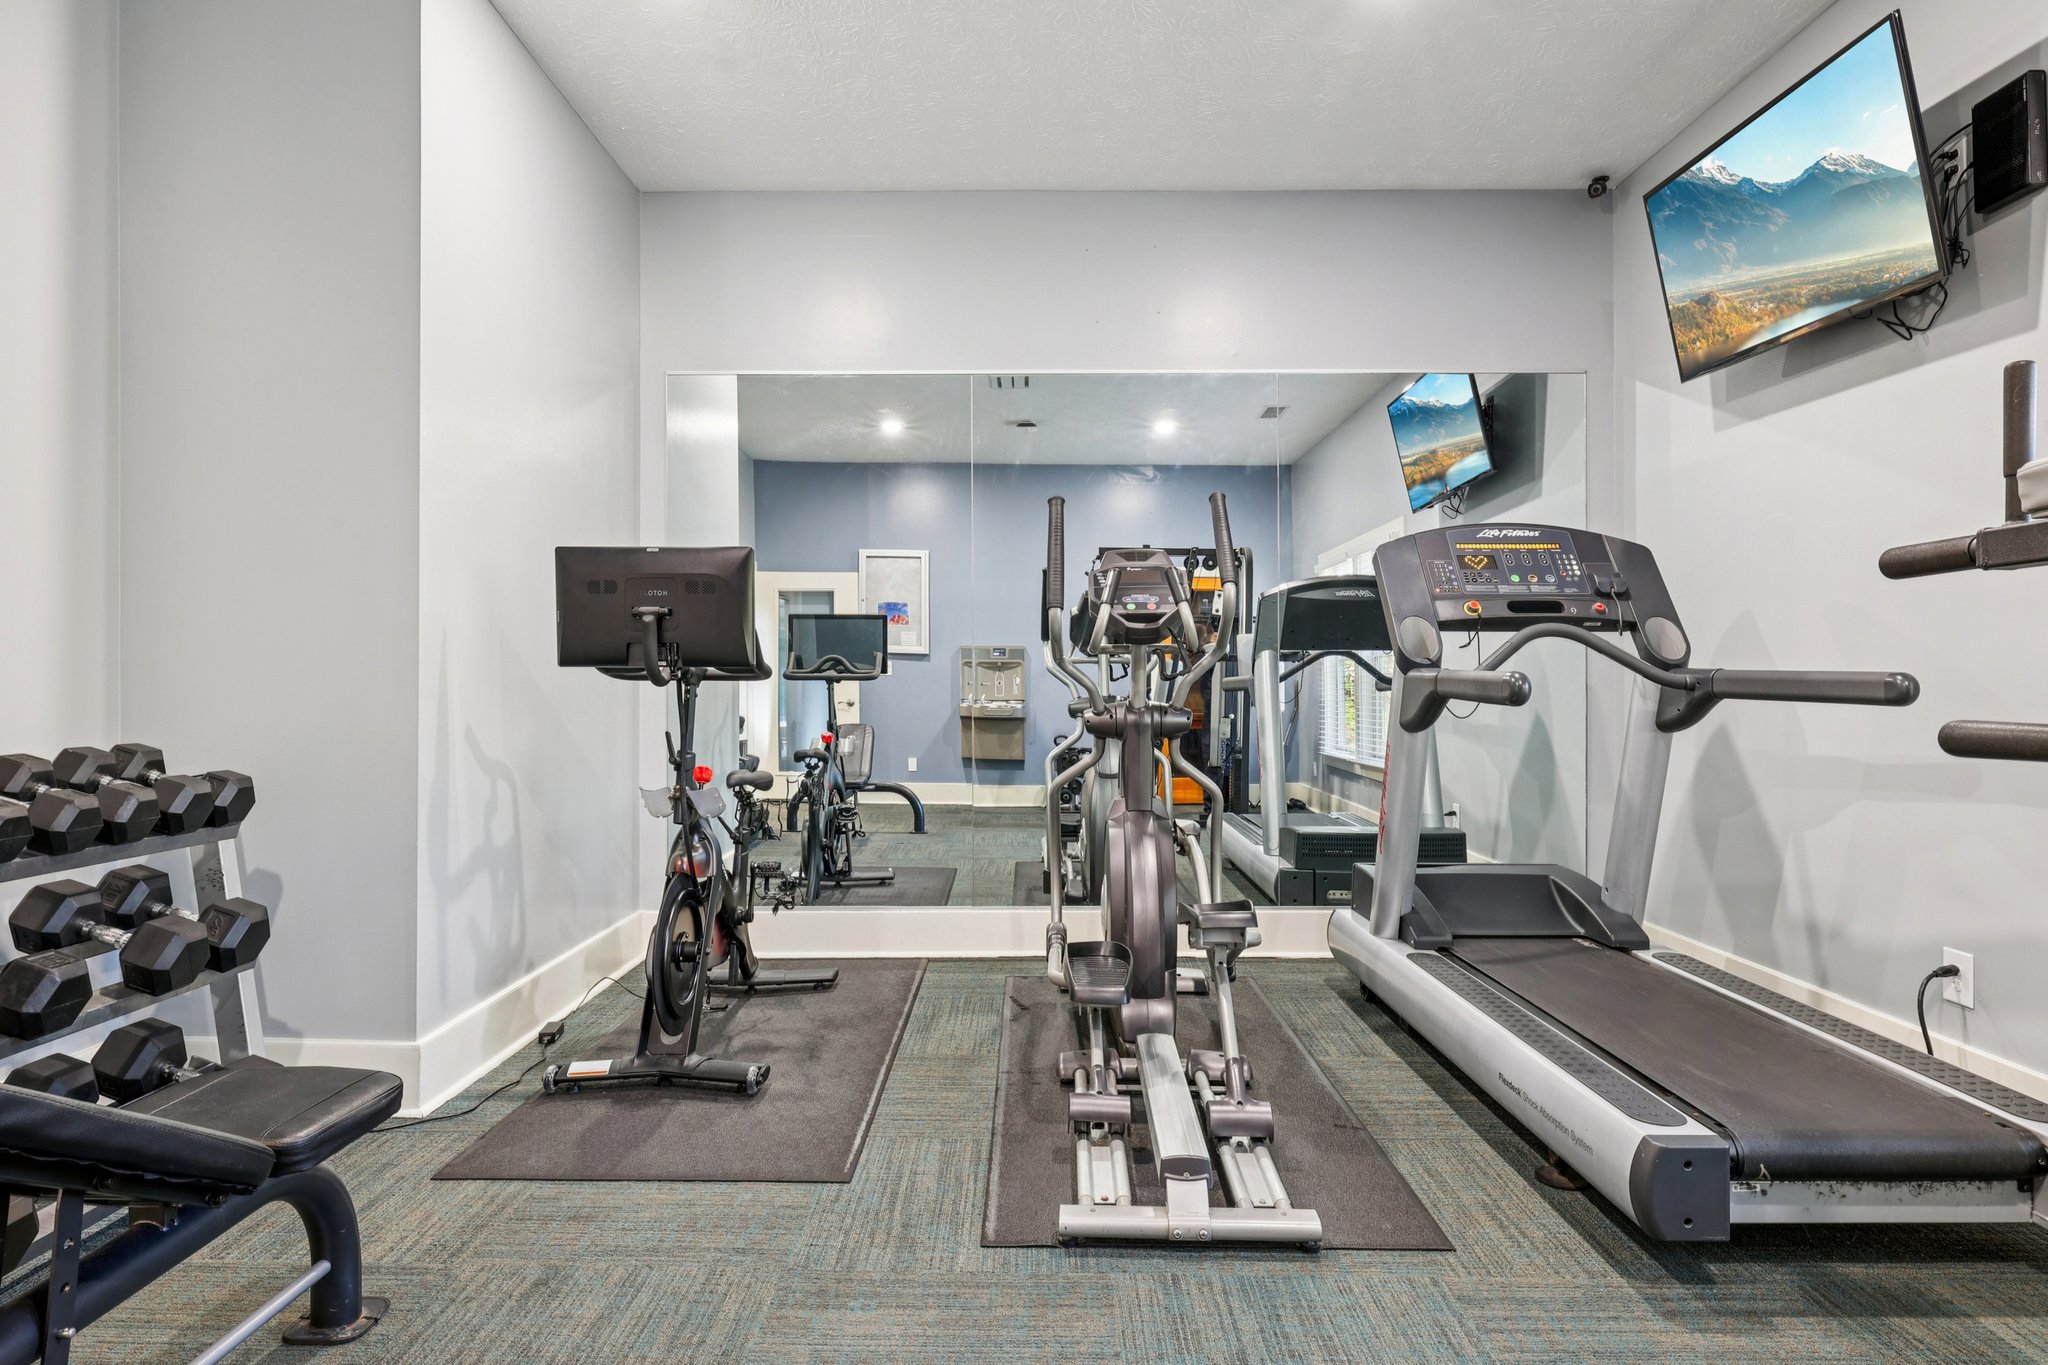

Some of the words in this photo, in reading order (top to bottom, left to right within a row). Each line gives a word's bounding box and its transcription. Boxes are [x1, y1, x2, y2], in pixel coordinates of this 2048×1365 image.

[1522, 1091, 1540, 1112] Shock
[1539, 1105, 1570, 1137] Absorption
[1570, 1129, 1594, 1156] System
